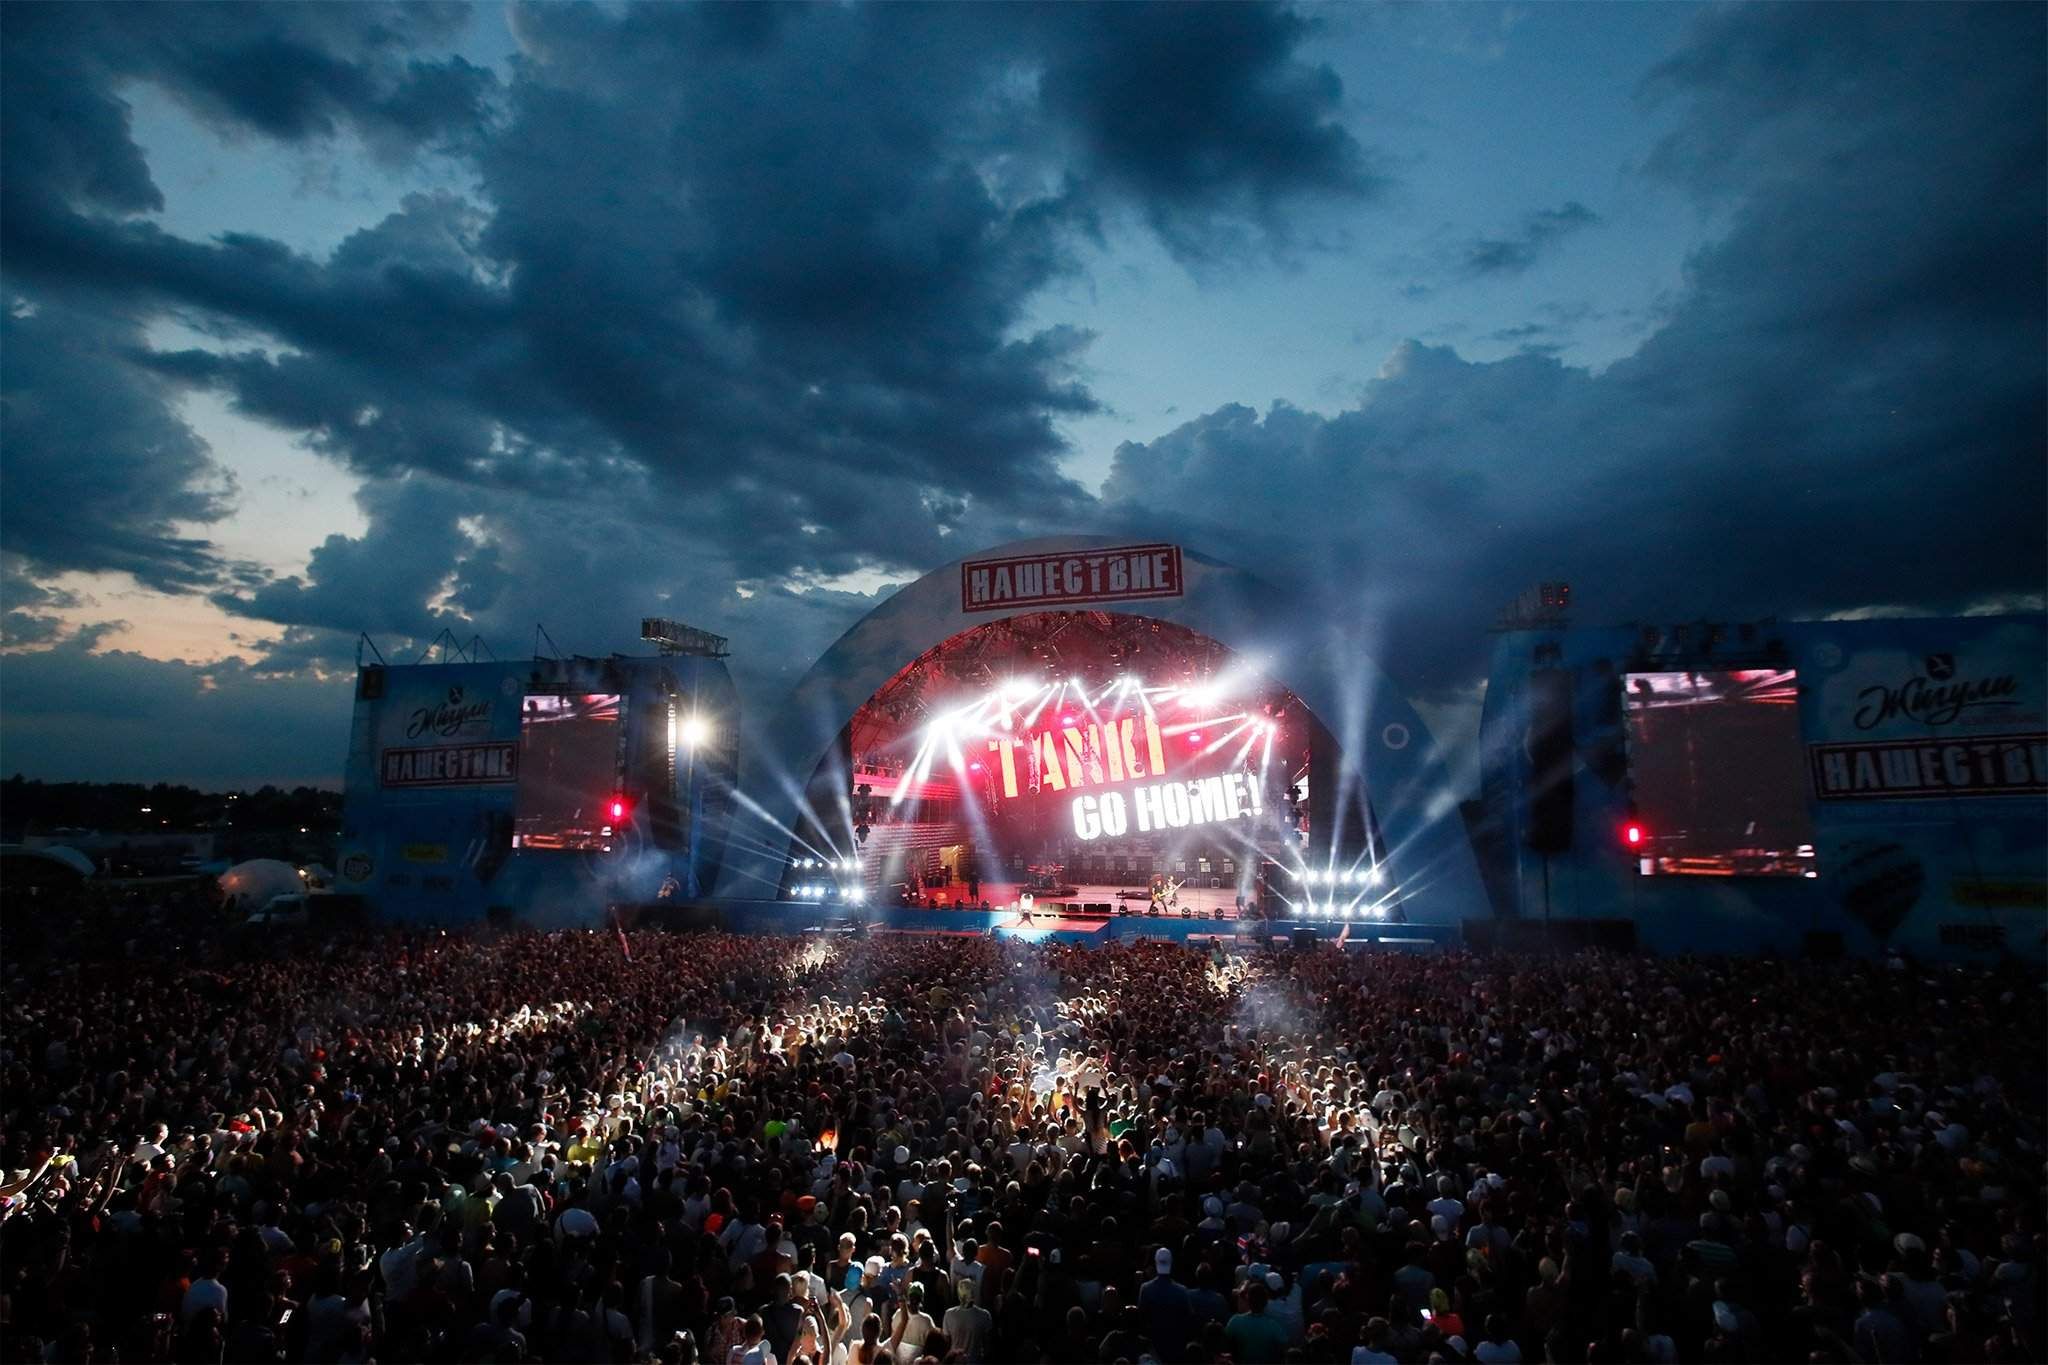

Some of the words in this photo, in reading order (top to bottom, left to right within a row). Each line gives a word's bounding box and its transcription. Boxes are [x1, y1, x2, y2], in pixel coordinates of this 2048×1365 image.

[970, 552, 1170, 603] НАШЕСТВИЕ
[1854, 675, 2020, 729] Жигули
[988, 714, 1166, 798] TANKI
[1071, 791, 1128, 841] GO
[1133, 770, 1263, 832] HOME!
